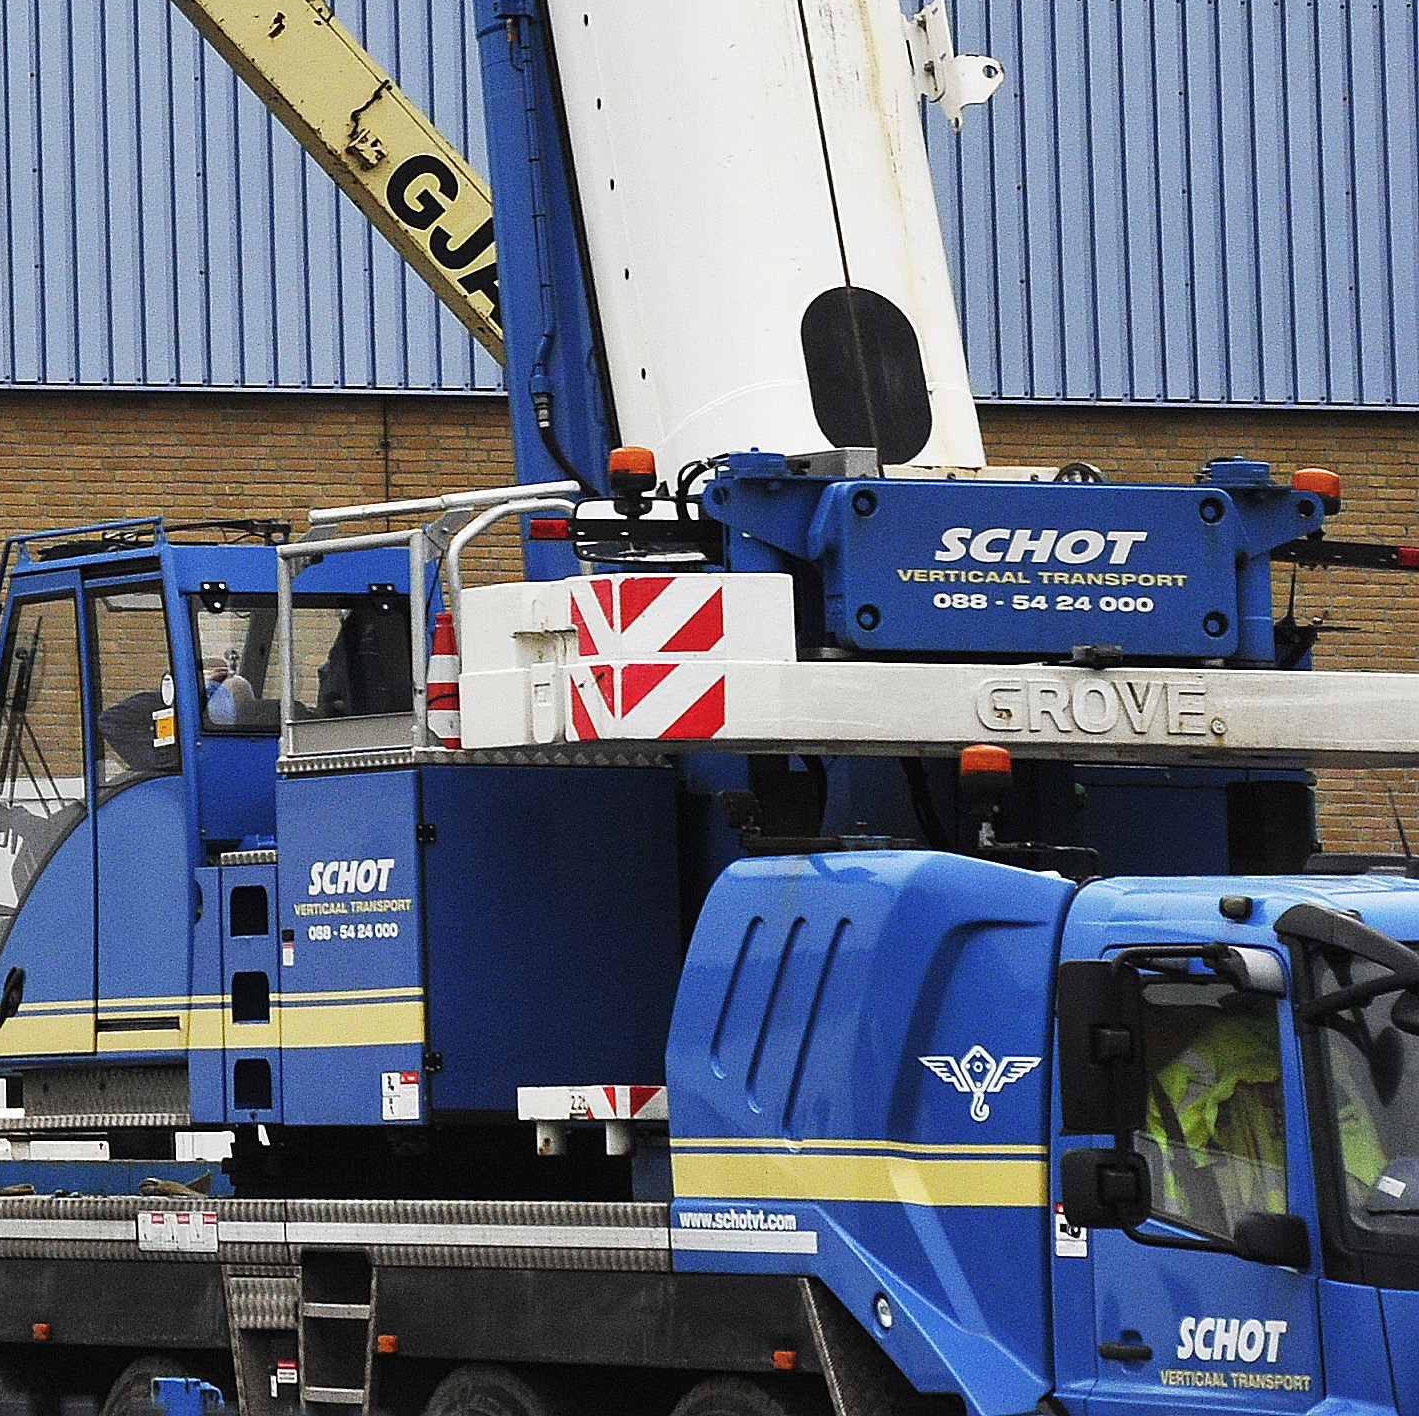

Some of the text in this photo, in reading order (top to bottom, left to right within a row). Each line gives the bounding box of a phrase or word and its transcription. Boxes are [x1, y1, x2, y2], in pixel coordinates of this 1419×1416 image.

[935, 527, 1148, 564] SCHOT
[897, 569, 1188, 587] VERTICAAL TRANSPORT
[933, 593, 988, 609] 088
[1012, 595, 1048, 610] 54
[1056, 596, 1092, 611] 24
[1099, 596, 1154, 612] 000
[977, 678, 1207, 735] GROVE
[308, 859, 394, 895] SCHOT
[294, 898, 412, 917] VERTICAAL TRANSPORT
[308, 925, 331, 941] 088
[339, 924, 356, 939] 54
[357, 923, 373, 939] 24
[374, 922, 399, 938] 000
[679, 1208, 797, 1230] www.schotvt.com
[1177, 1317, 1288, 1363] SCHOT
[1161, 1369, 1312, 1391] VERTICAAL TRANSPORT
